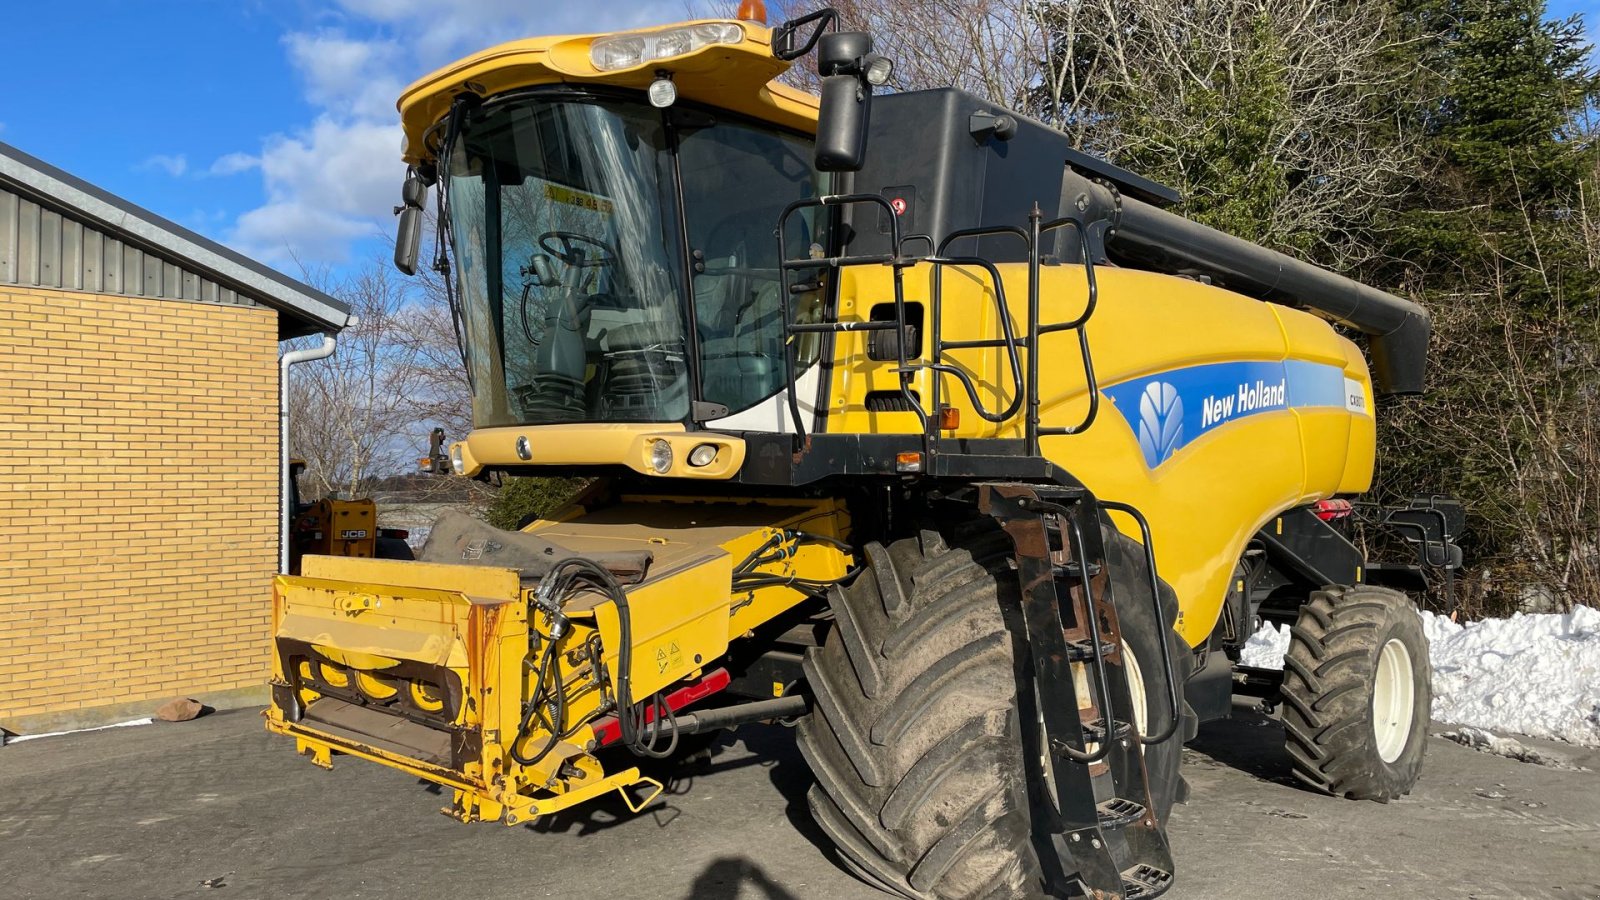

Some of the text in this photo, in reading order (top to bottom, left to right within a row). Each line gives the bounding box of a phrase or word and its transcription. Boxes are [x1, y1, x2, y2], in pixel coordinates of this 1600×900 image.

[1202, 378, 1285, 428] New Holland
[341, 530, 366, 538] JCB
